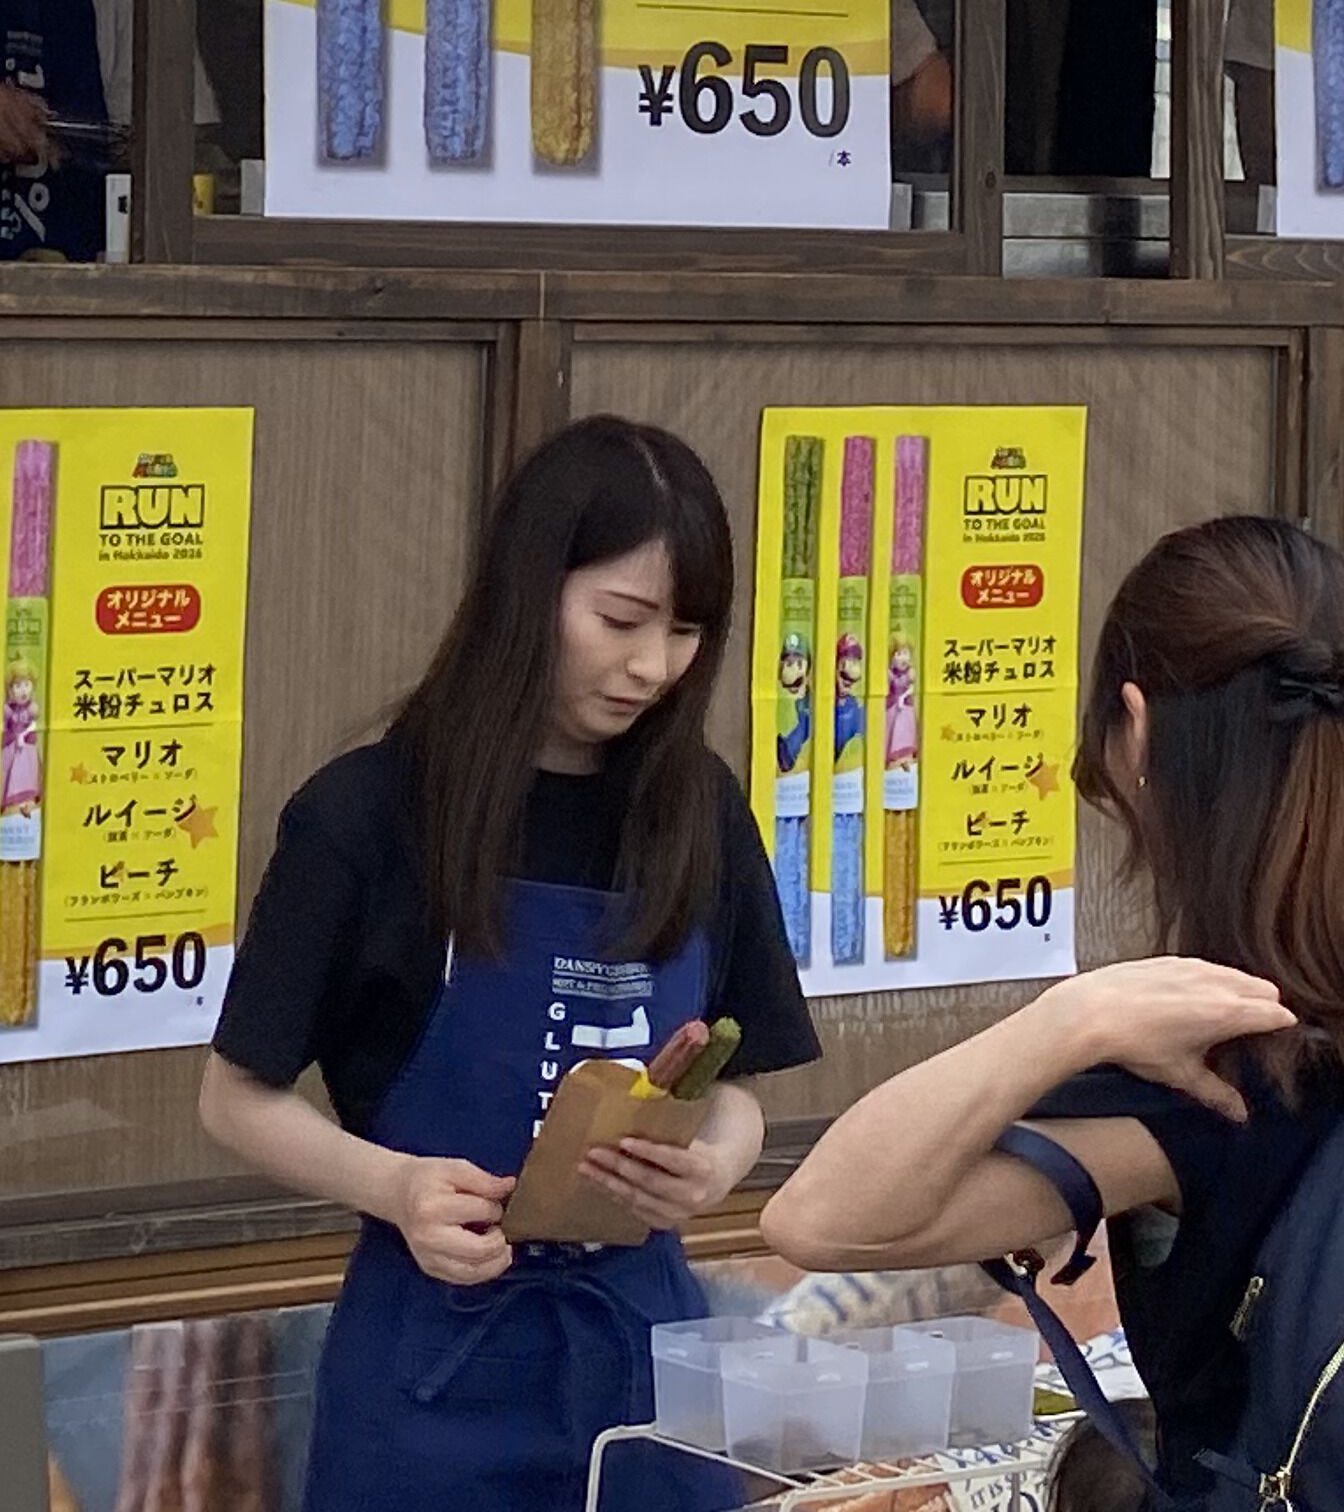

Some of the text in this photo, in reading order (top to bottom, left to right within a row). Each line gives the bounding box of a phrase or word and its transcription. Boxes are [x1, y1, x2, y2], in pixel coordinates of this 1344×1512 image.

[638, 41, 850, 138] ¥650
[100, 484, 205, 530] RUN
[963, 475, 1048, 515] RUN
[964, 517, 1046, 530] TO THE GOAL
[99, 532, 203, 547] TO THE GOAL
[970, 569, 1037, 587] オリジナル
[107, 589, 191, 609] オリジナル
[977, 590, 1030, 604] メニュー
[114, 612, 182, 629] メニュー
[944, 636, 1057, 658] スーパーマリオ
[74, 664, 216, 689] スーパーマリオ
[943, 660, 1055, 685] 米粉チュロス
[73, 692, 214, 721] 米粉チュロス
[966, 703, 1032, 729] マリオ
[101, 740, 182, 769] マリオ
[951, 753, 1043, 780] ルイージ
[83, 794, 197, 827] ルイージ
[967, 810, 1030, 836] ピーチ
[100, 859, 179, 889] ピーチ
[939, 875, 1052, 932] ¥650
[65, 931, 206, 996] ¥650
